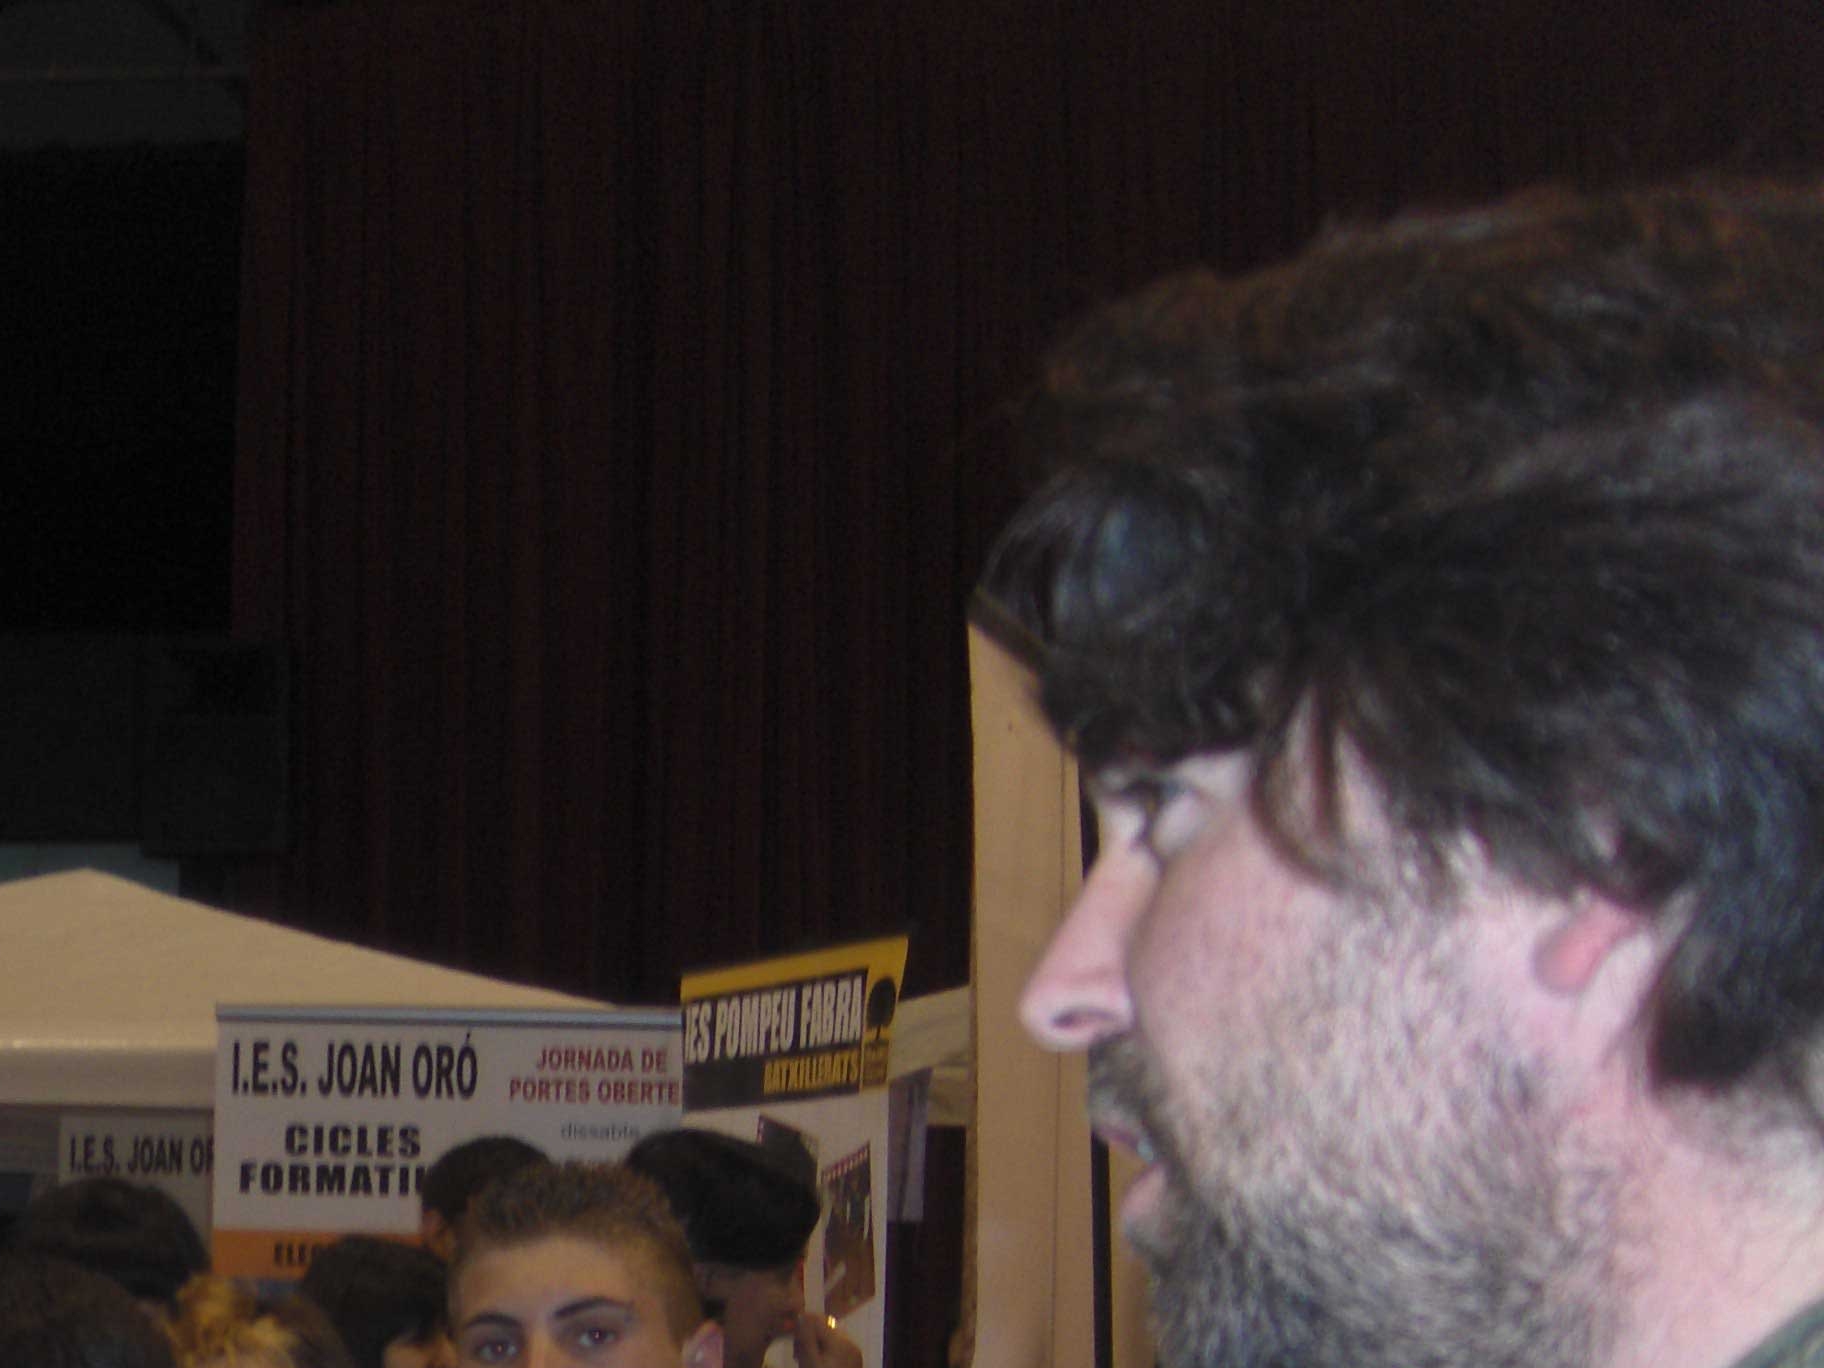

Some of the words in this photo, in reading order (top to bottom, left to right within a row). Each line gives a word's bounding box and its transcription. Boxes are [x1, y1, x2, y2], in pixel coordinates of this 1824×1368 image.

[684, 1000, 711, 1064] IES
[714, 986, 797, 1061] POMPEU
[800, 975, 863, 1048] FABRA
[232, 1040, 307, 1096] I.E.S.
[318, 1041, 401, 1097] JOAN
[412, 1030, 479, 1098] ORÓ
[536, 1045, 634, 1073] JORNADA
[641, 1049, 668, 1074] DE
[509, 1078, 591, 1104] PORTES
[128, 1136, 183, 1174] JOAN
[285, 1124, 421, 1157] CICLES
